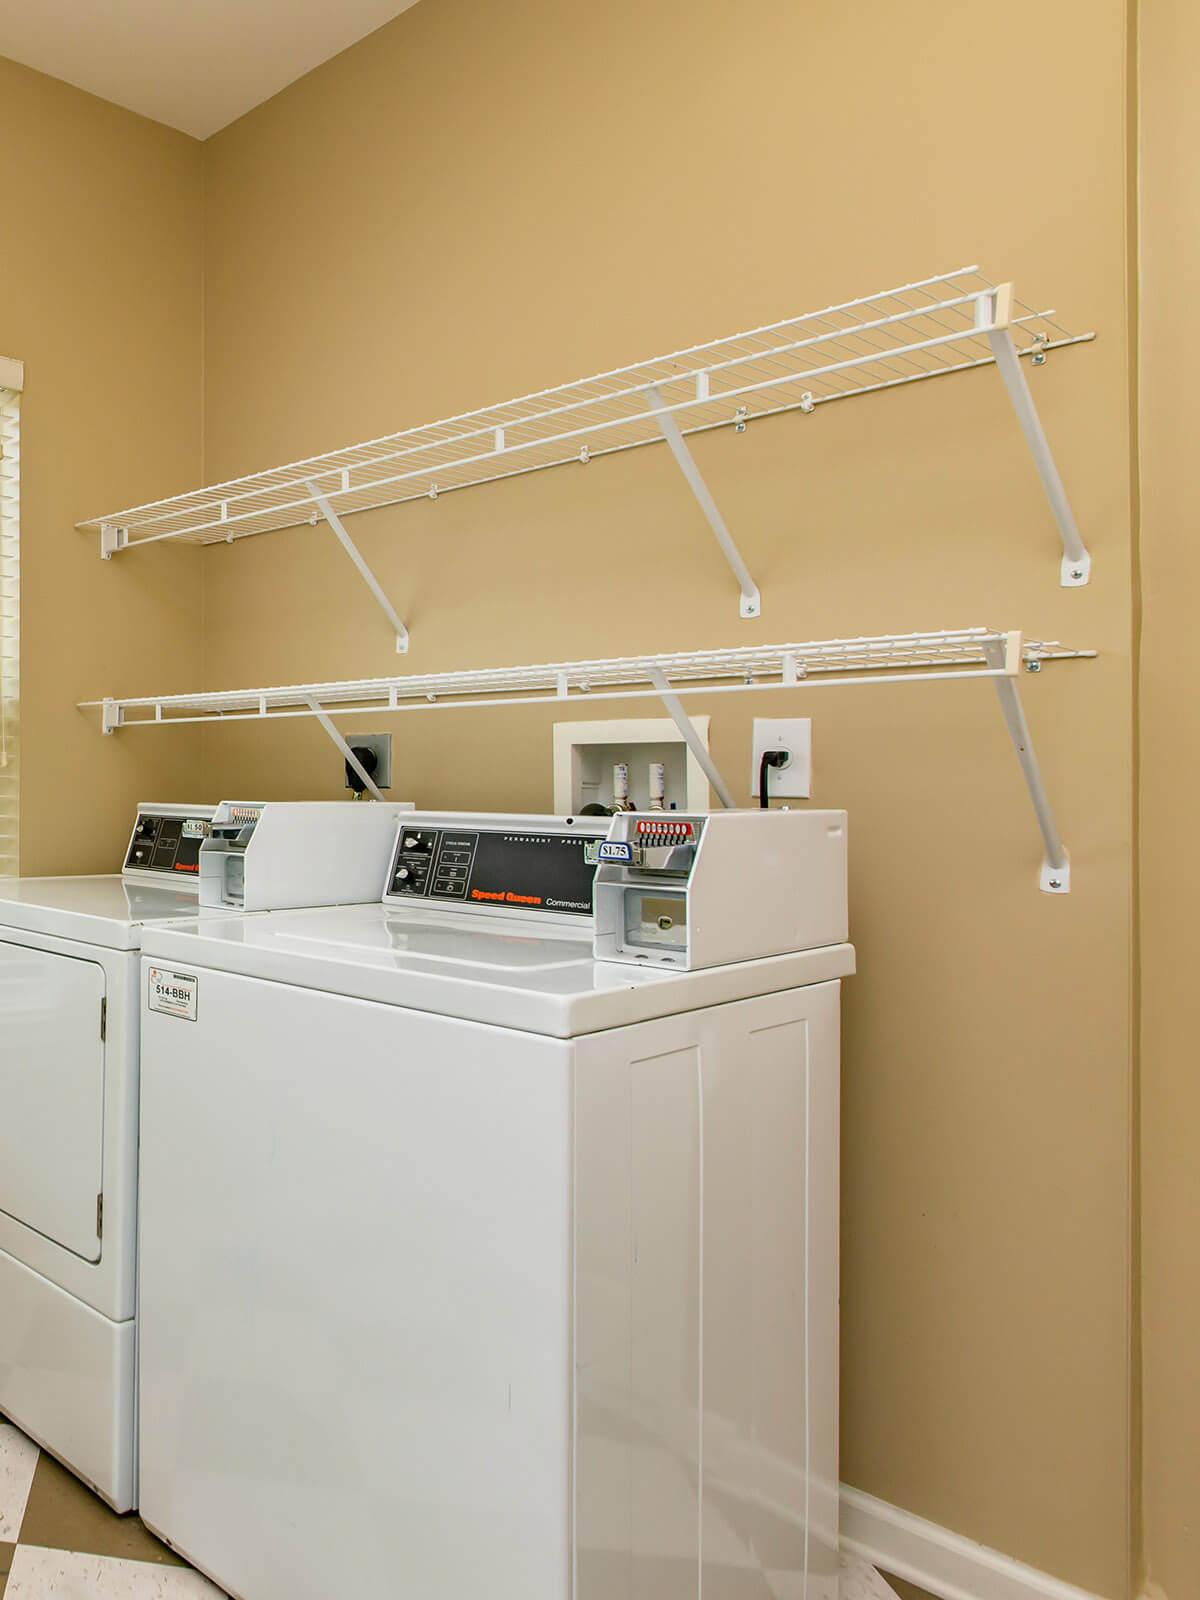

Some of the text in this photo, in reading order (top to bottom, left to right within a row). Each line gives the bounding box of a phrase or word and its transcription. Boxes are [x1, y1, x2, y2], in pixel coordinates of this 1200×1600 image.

[603, 845, 626, 856] $1.75
[471, 889, 591, 909] Speed Queen Commercial
[156, 984, 191, 1001] 514-BBH
